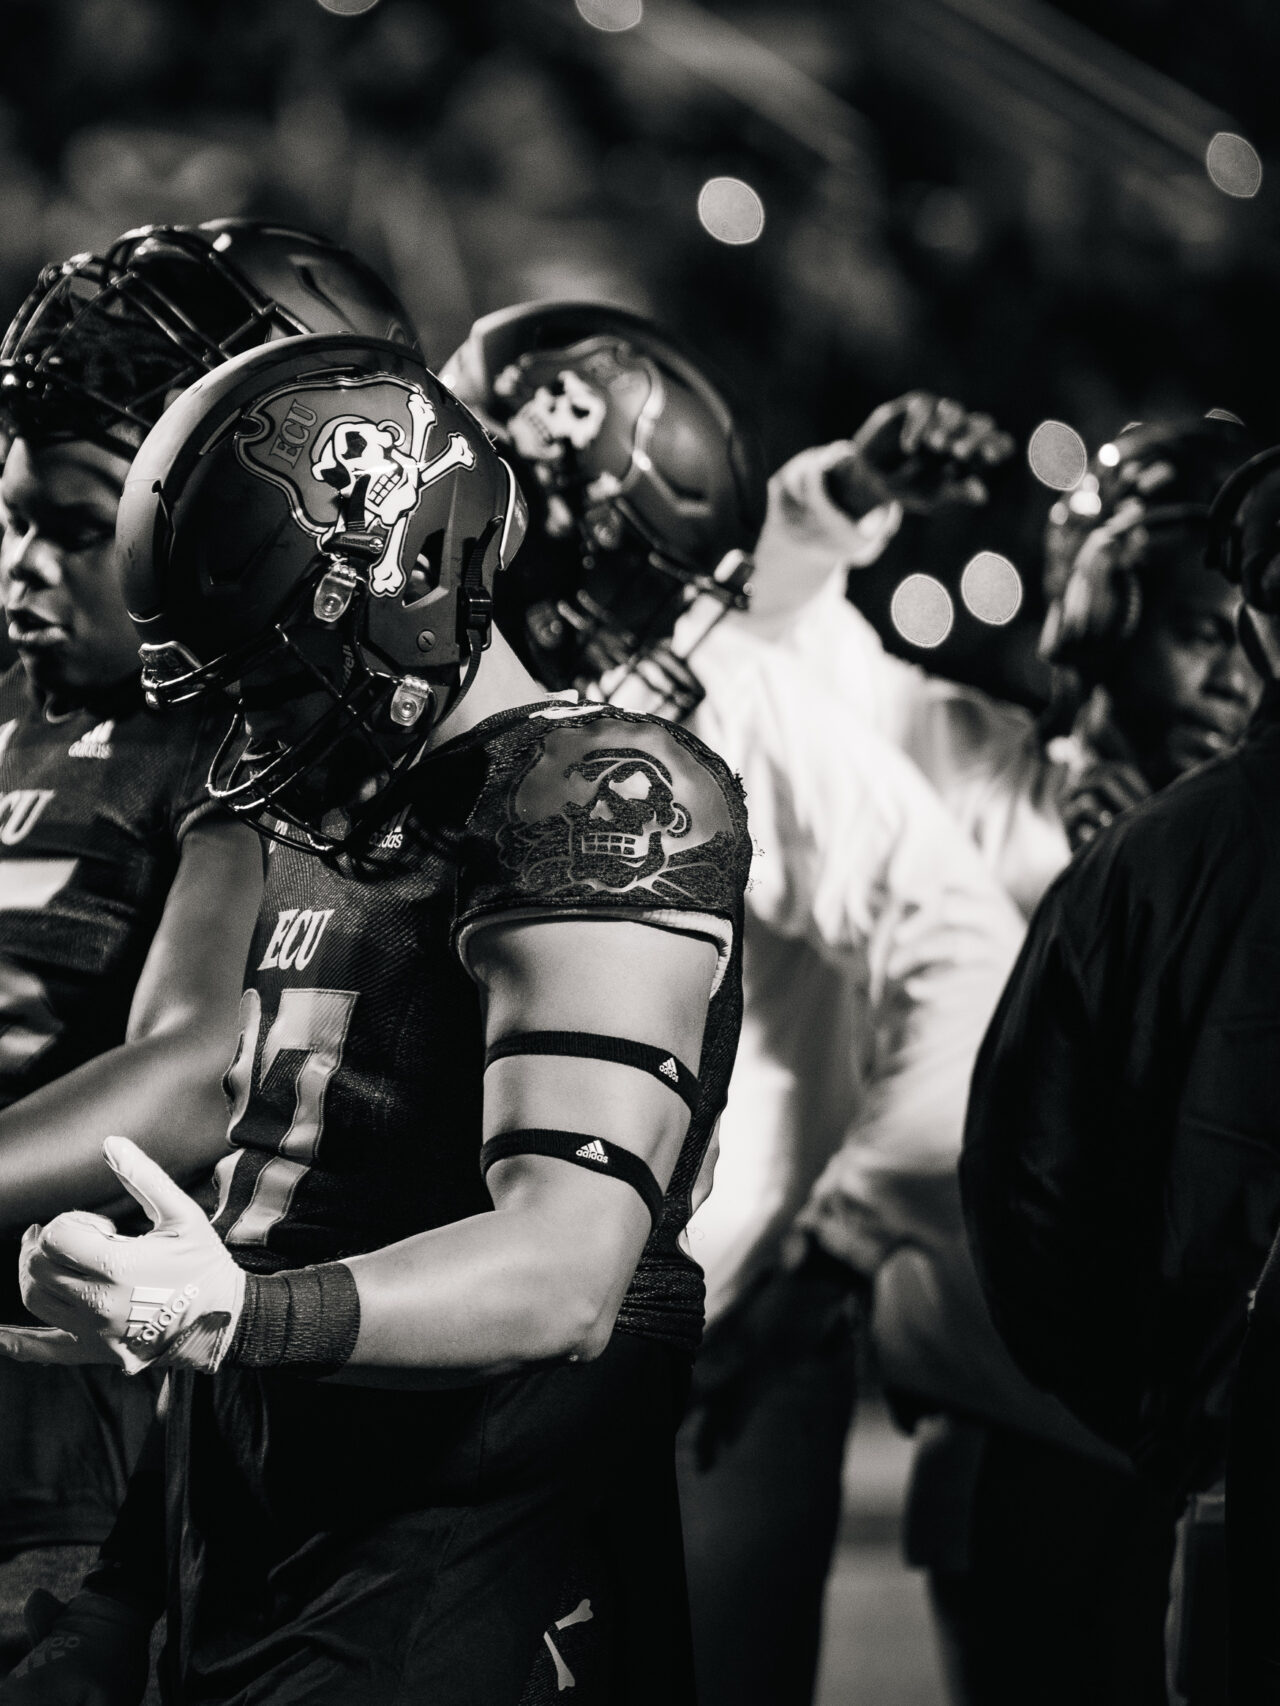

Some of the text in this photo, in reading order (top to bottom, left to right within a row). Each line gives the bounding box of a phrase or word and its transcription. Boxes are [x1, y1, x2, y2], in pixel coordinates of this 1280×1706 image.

[269, 399, 318, 469] ECU
[256, 908, 336, 971] ECU
[575, 1149, 609, 1164] adidas
